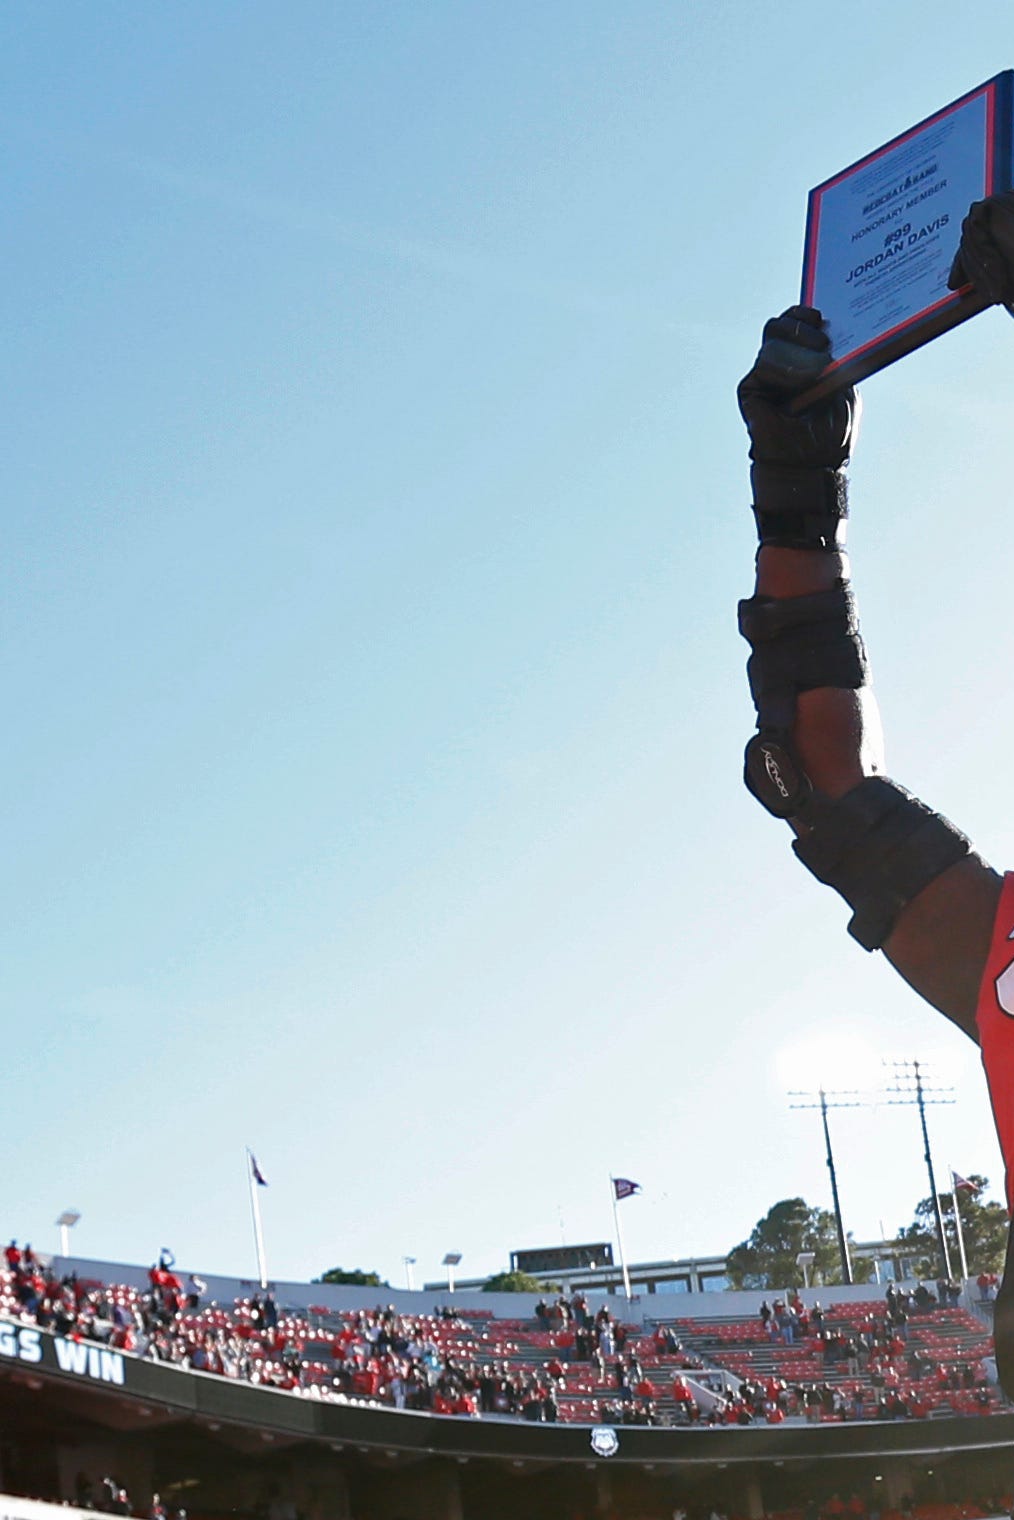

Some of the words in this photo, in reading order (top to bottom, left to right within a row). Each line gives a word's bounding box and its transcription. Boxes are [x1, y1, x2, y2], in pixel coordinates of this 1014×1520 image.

[851, 205, 904, 242] HONORARY
[905, 179, 948, 210] MEMBER
[884, 223, 912, 249] #99
[845, 240, 904, 283] JORDAN
[907, 214, 950, 247] DAVIS
[54, 1337, 125, 1386] WIN
